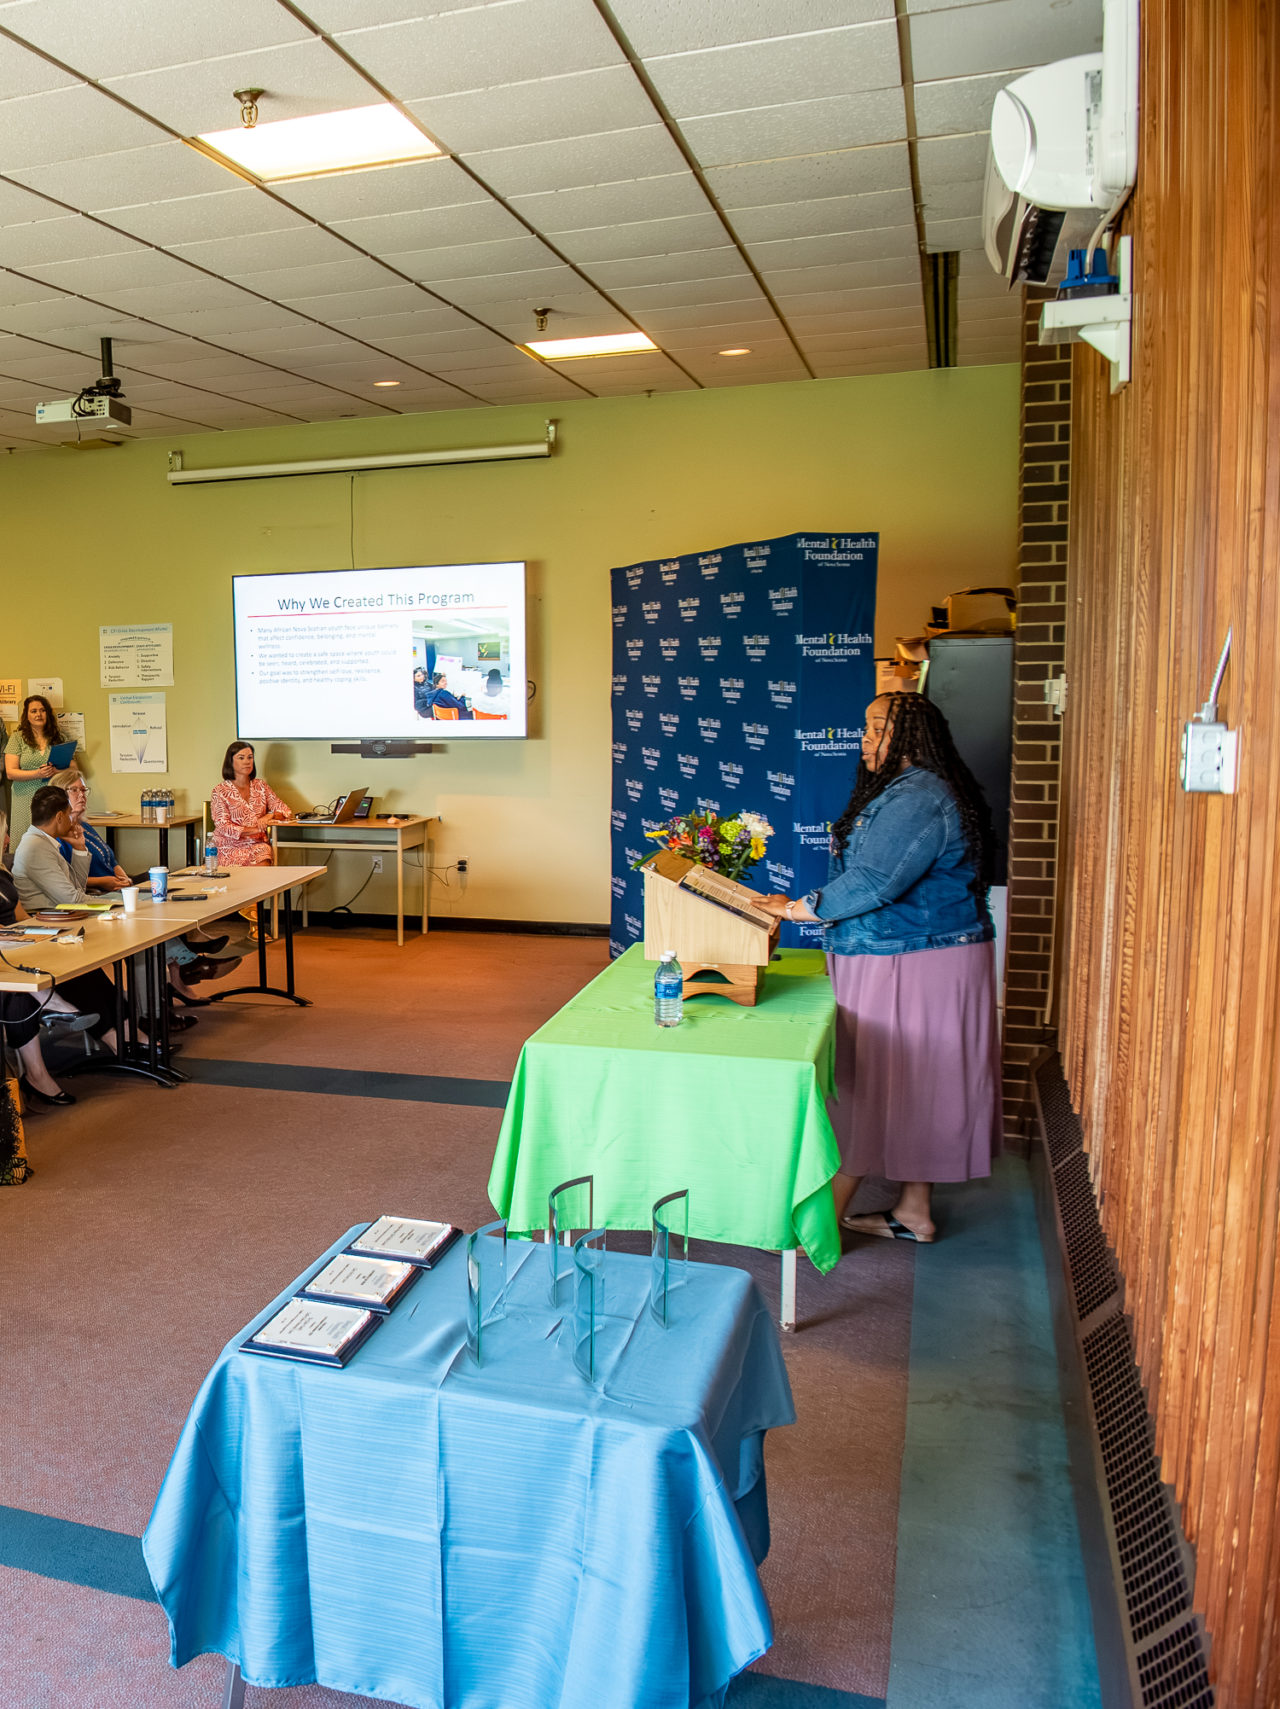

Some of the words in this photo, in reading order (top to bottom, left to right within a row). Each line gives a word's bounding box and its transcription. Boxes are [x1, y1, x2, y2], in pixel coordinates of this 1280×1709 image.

[796, 537, 830, 548] Mental
[840, 538, 876, 549] Health
[804, 549, 864, 560] Foundation
[278, 598, 306, 612] Why
[309, 597, 330, 609] We
[334, 594, 384, 608] Created
[387, 594, 414, 605] This
[418, 593, 474, 607] Program
[794, 634, 827, 645] Mental
[837, 633, 872, 644] Health
[802, 646, 861, 657] Foundation
[793, 728, 826, 740] Mental
[801, 740, 860, 751] Foundation
[792, 822, 825, 833] Mental
[800, 834, 832, 845] Found
